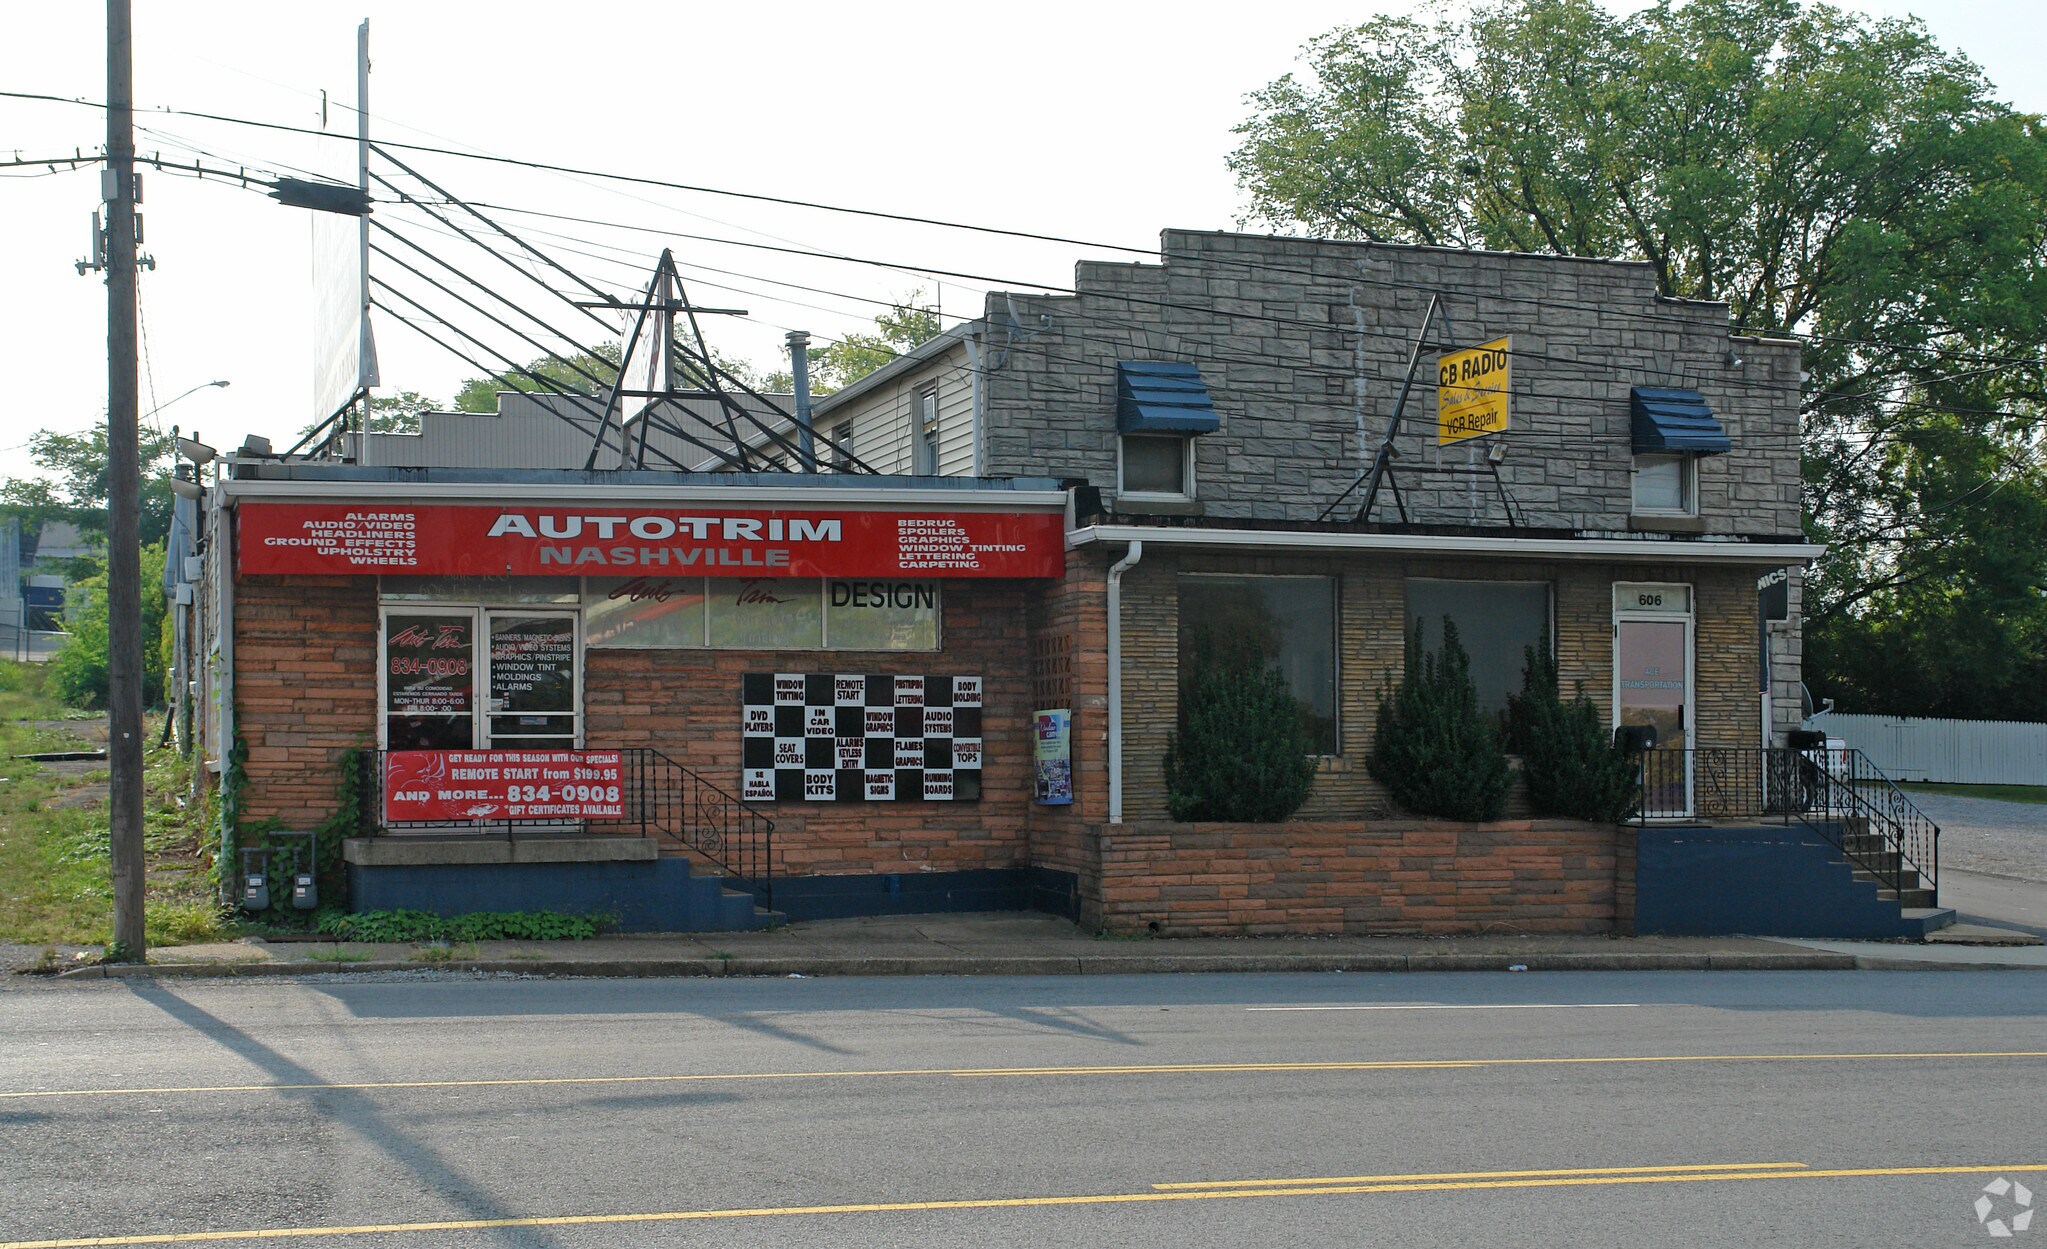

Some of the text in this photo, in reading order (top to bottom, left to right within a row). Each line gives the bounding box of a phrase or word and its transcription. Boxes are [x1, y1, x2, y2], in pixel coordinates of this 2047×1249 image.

[1440, 347, 1507, 387] CB RADIO
[1441, 390, 1462, 411] Sales
[1471, 381, 1501, 403] Service
[1447, 408, 1498, 435] VCR Repair
[345, 512, 415, 521] ALARMS
[302, 520, 416, 530] AUDIO/VIDEO
[486, 514, 842, 541] AUTO-TRIM
[897, 519, 956, 527] BEDRUG
[311, 529, 416, 539] HEADLINERS
[898, 528, 966, 536] SPOILERS
[264, 537, 416, 548] GROUND EFFECTS
[898, 536, 970, 544] GRAPHICS
[317, 547, 416, 557] UPHOLSTRY
[899, 544, 1026, 552] WINDOW TINTING
[349, 556, 418, 565] WHEELS
[539, 546, 790, 567] NASHVILLE
[898, 561, 980, 569] CARPETING
[831, 582, 934, 609] DESIGN
[1639, 594, 1662, 606] 606
[388, 625, 473, 650] Auto Trim
[540, 644, 571, 652] SYSTEMS
[391, 657, 467, 675] 834-0908
[495, 663, 557, 671] WINDOW TINT
[495, 683, 533, 691] ALARMS
[776, 680, 804, 689] WINDOW
[836, 680, 864, 689] REMOTE
[958, 682, 977, 691] BODY
[1621, 680, 1684, 689] TRANSPORTATION
[776, 691, 804, 701] TINTING
[837, 691, 861, 700] START
[895, 695, 923, 704] LETTERING
[953, 693, 981, 702] MOLDING
[750, 711, 768, 720] DVD
[814, 709, 826, 717] IN
[866, 712, 894, 721] WINDOW
[925, 712, 952, 721] AUDIO
[744, 723, 774, 732] PLAYERS
[865, 723, 894, 733] GRAPHICS
[924, 724, 952, 733] SYSTEMS
[779, 743, 796, 753] SEAT
[836, 738, 864, 748] ALARMS
[895, 741, 924, 751] FLAMES
[953, 743, 981, 752] CONVERTIBLE
[838, 749, 862, 758] KEYLESS
[957, 753, 978, 763] TOPS
[449, 754, 462, 763] GET
[464, 754, 487, 763] READY
[489, 754, 503, 763] FOR
[505, 754, 521, 763] THIS
[522, 754, 550, 763] SEASON
[552, 754, 569, 762] WITH
[586, 755, 619, 764] SPECIALS!
[775, 754, 804, 764] COVERS
[895, 757, 923, 766] GRAPHICS
[841, 760, 859, 769] ENTRY
[451, 768, 618, 781] REMOTE START from $199.95
[806, 774, 834, 784] BODY
[865, 773, 894, 783] MAGNETIC
[924, 773, 953, 783] RUNNING
[393, 785, 620, 803] AND MORE... 834-0908
[745, 788, 774, 798] ESPAÑOL
[806, 785, 834, 795] KITS
[869, 785, 889, 795] SIGNS
[924, 785, 953, 795] BOARDS
[528, 804, 580, 816] CERTIFICATES
[582, 804, 622, 816] AVAILABLE
